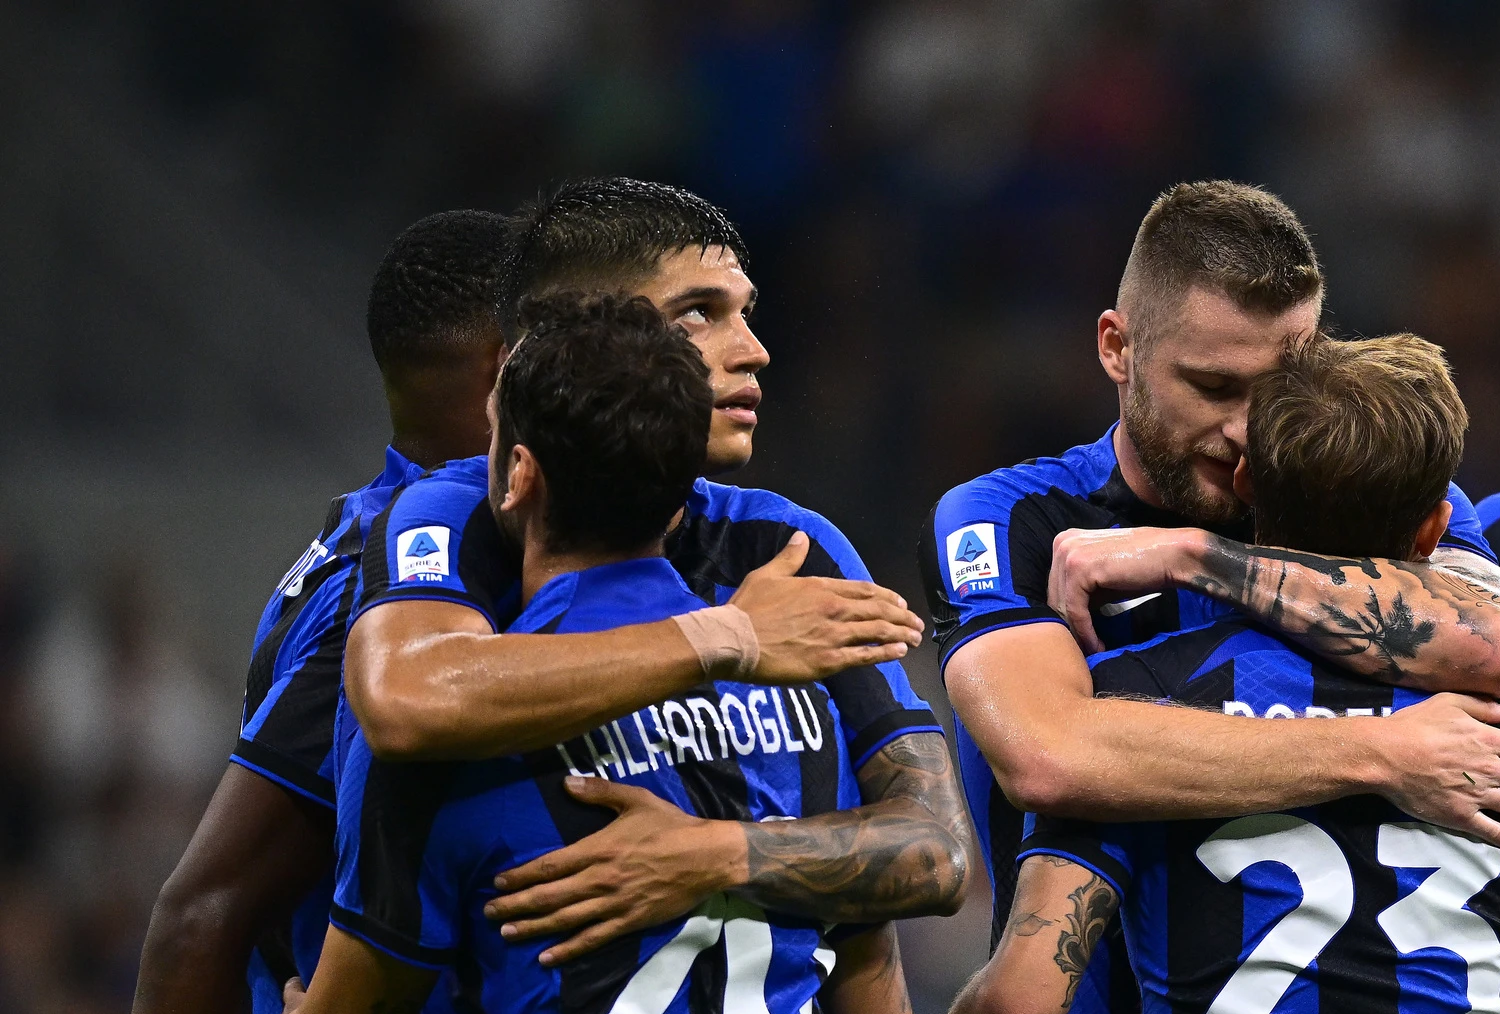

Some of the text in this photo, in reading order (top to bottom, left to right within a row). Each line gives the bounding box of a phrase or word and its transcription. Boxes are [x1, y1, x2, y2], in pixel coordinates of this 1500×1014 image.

[405, 560, 442, 571] SERIE A
[955, 562, 991, 579] SERIE A
[417, 573, 443, 582] TIM
[969, 580, 994, 591] TIM
